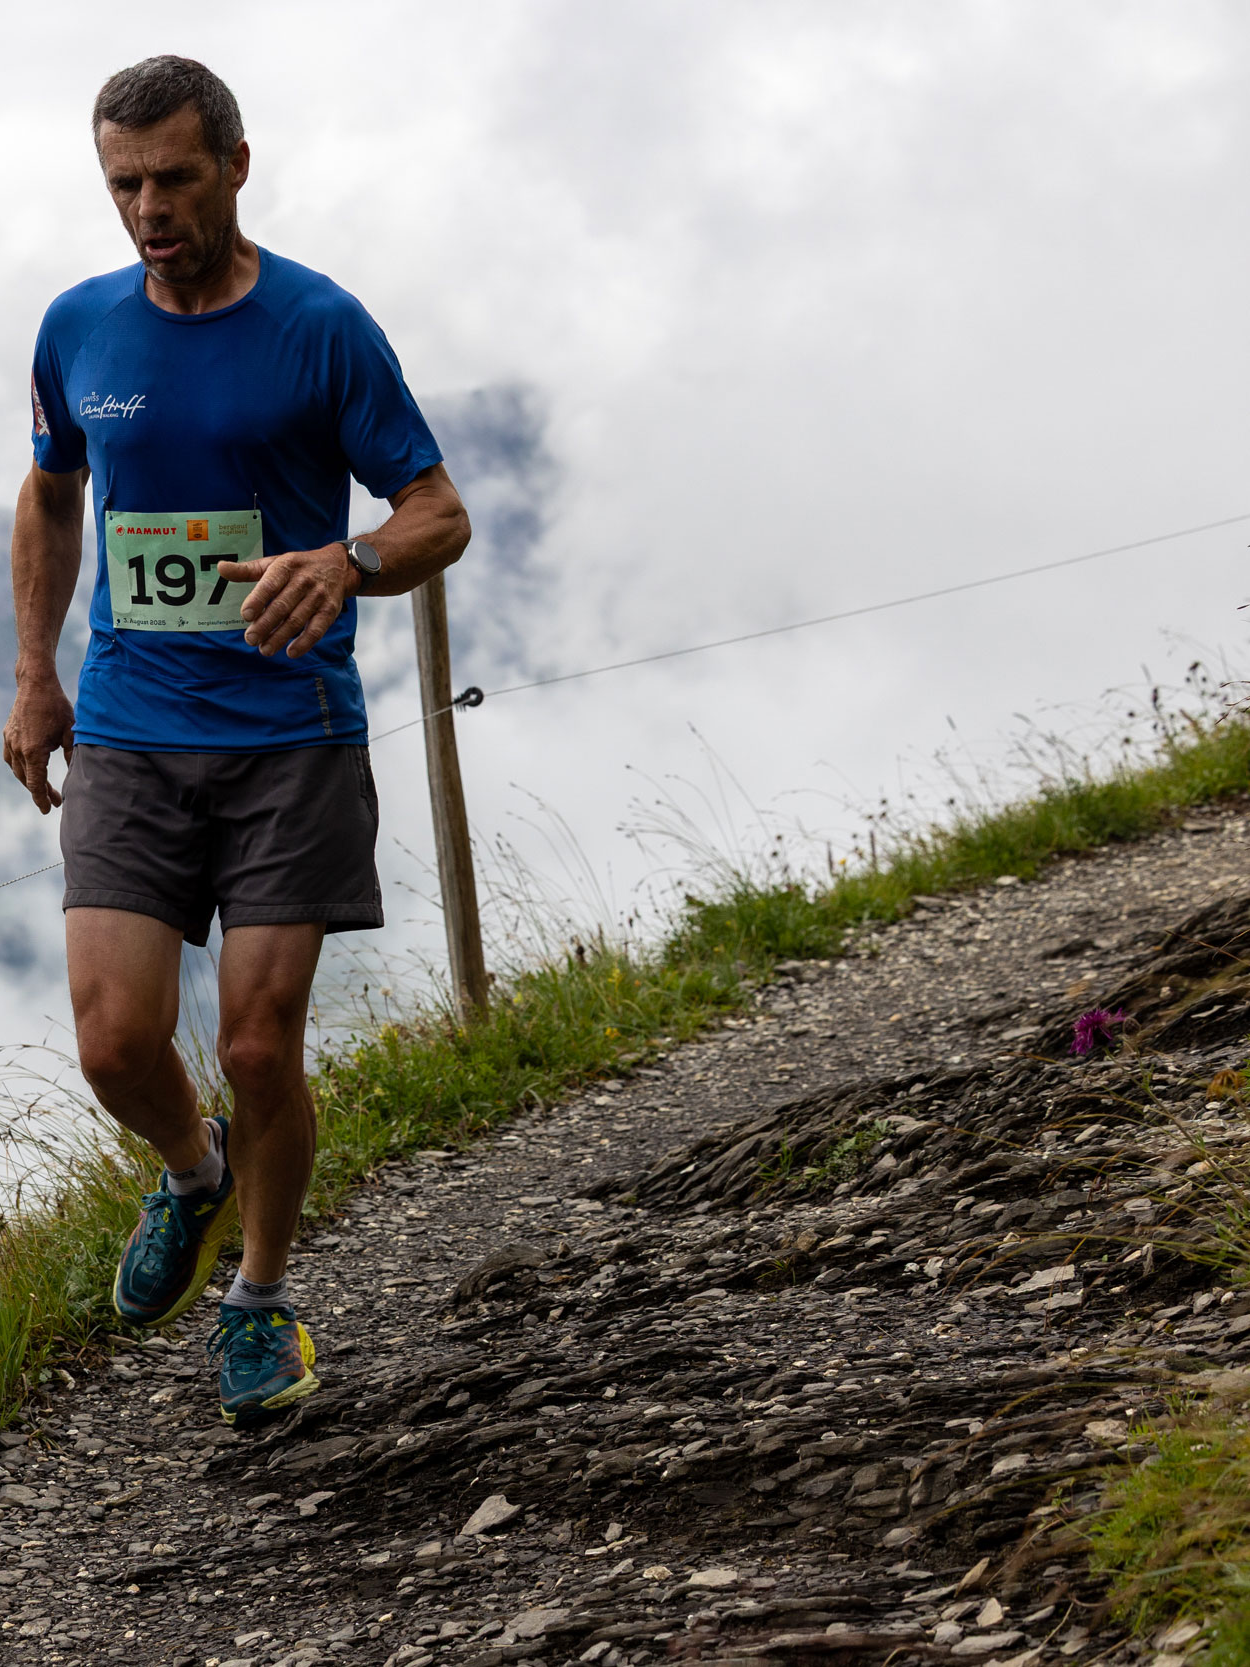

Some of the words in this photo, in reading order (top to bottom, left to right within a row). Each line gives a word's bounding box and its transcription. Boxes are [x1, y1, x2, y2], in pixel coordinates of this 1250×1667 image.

[127, 527, 177, 535] MAMMUT
[129, 554, 239, 606] 197
[130, 618, 149, 626] August
[315, 677, 333, 737] SALOMON
